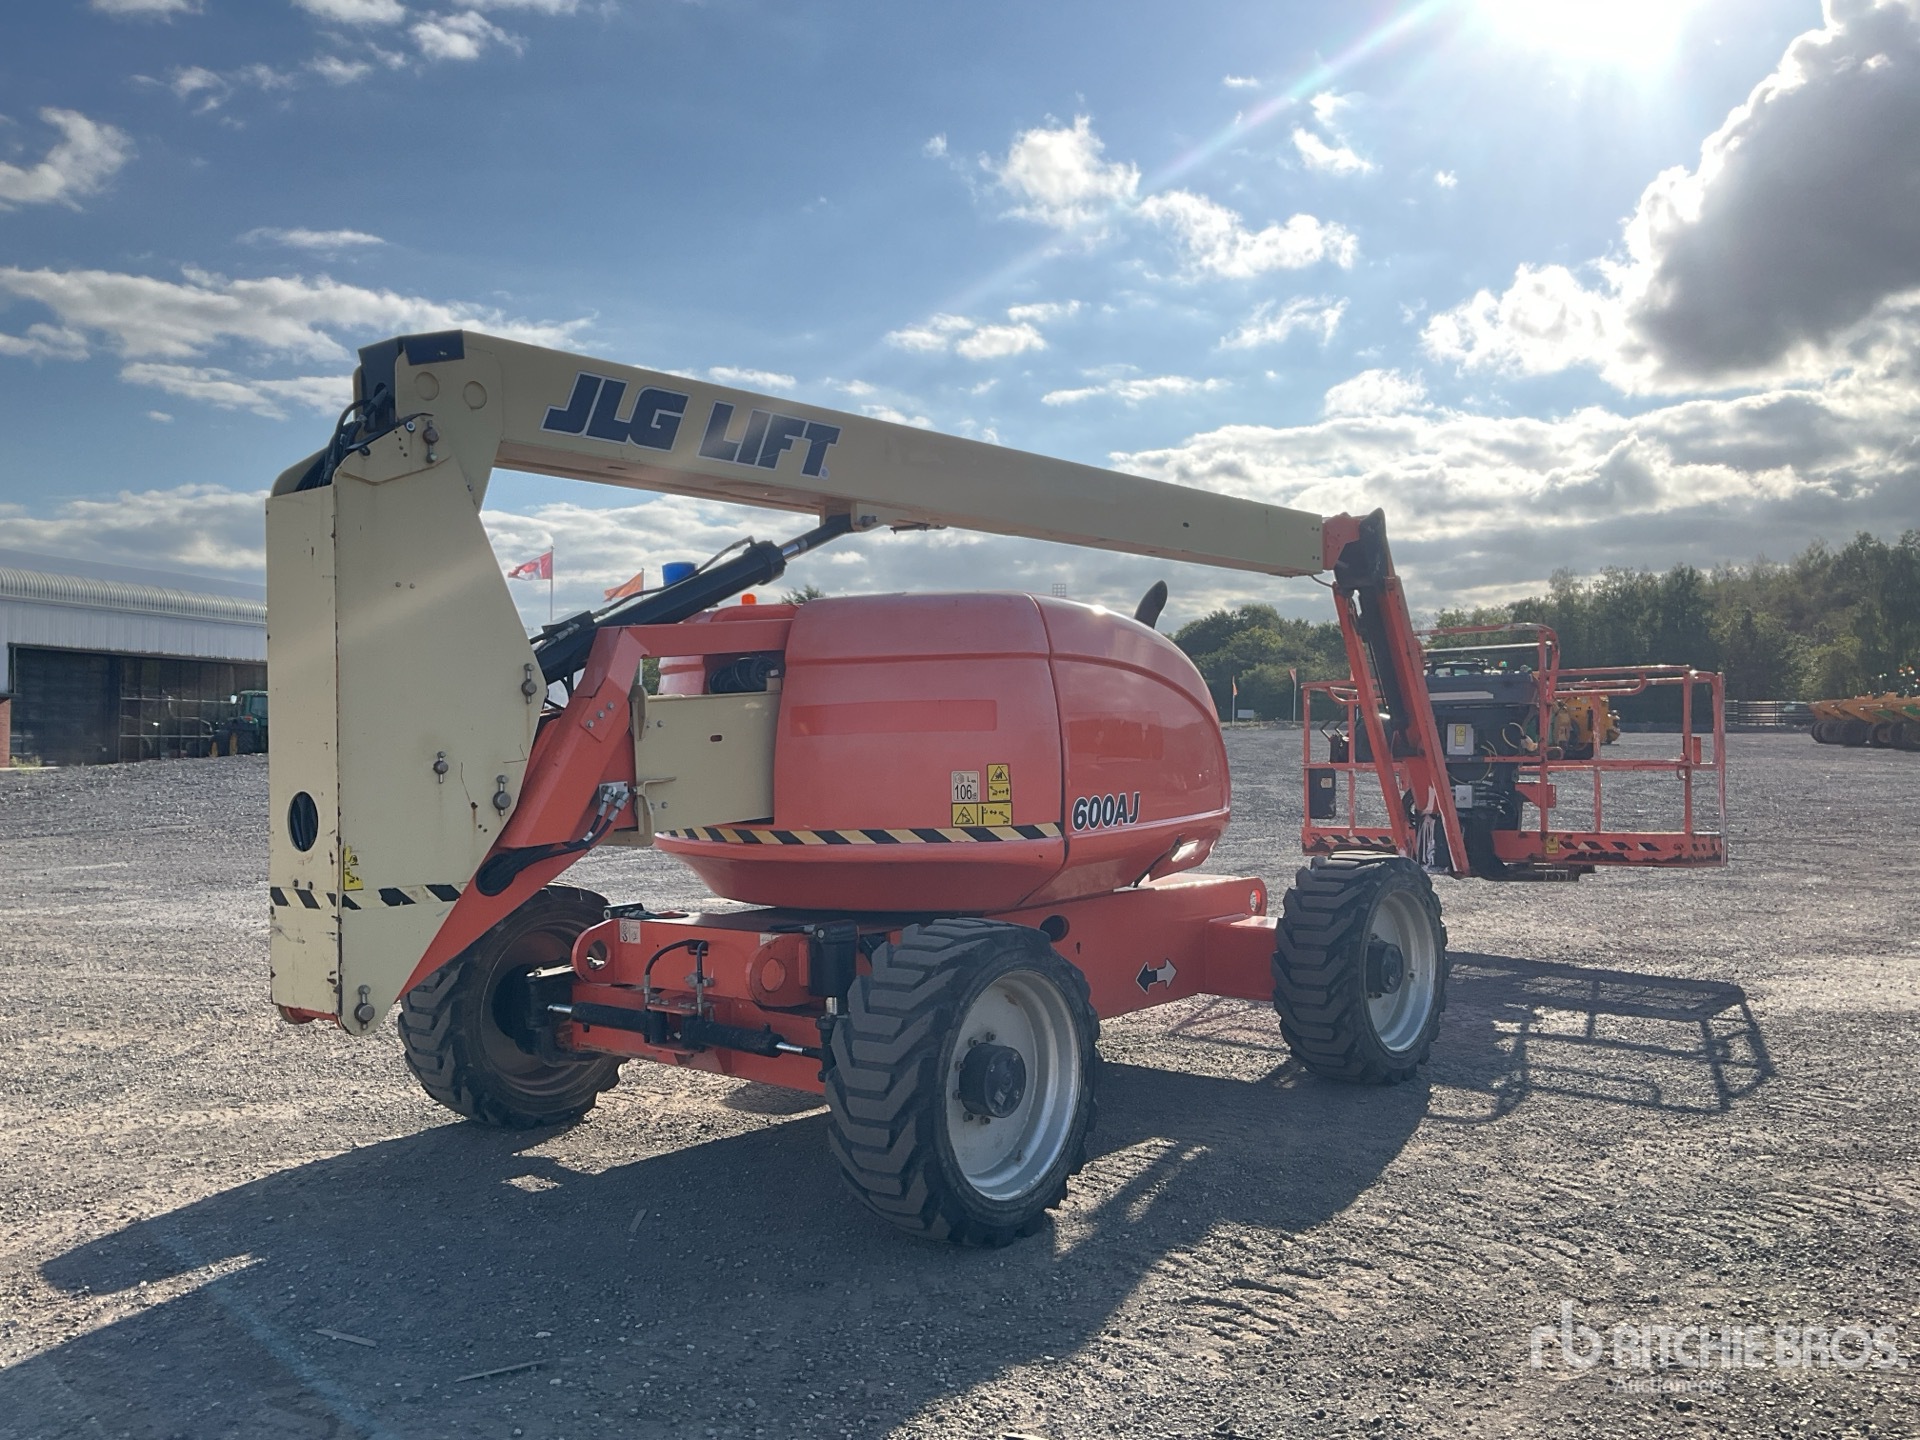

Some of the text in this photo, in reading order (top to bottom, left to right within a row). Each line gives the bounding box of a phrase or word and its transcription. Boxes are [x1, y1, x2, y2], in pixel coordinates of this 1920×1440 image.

[540, 370, 843, 478] JLG LIFT
[955, 784, 972, 800] 106
[1072, 791, 1140, 831] 600AJ
